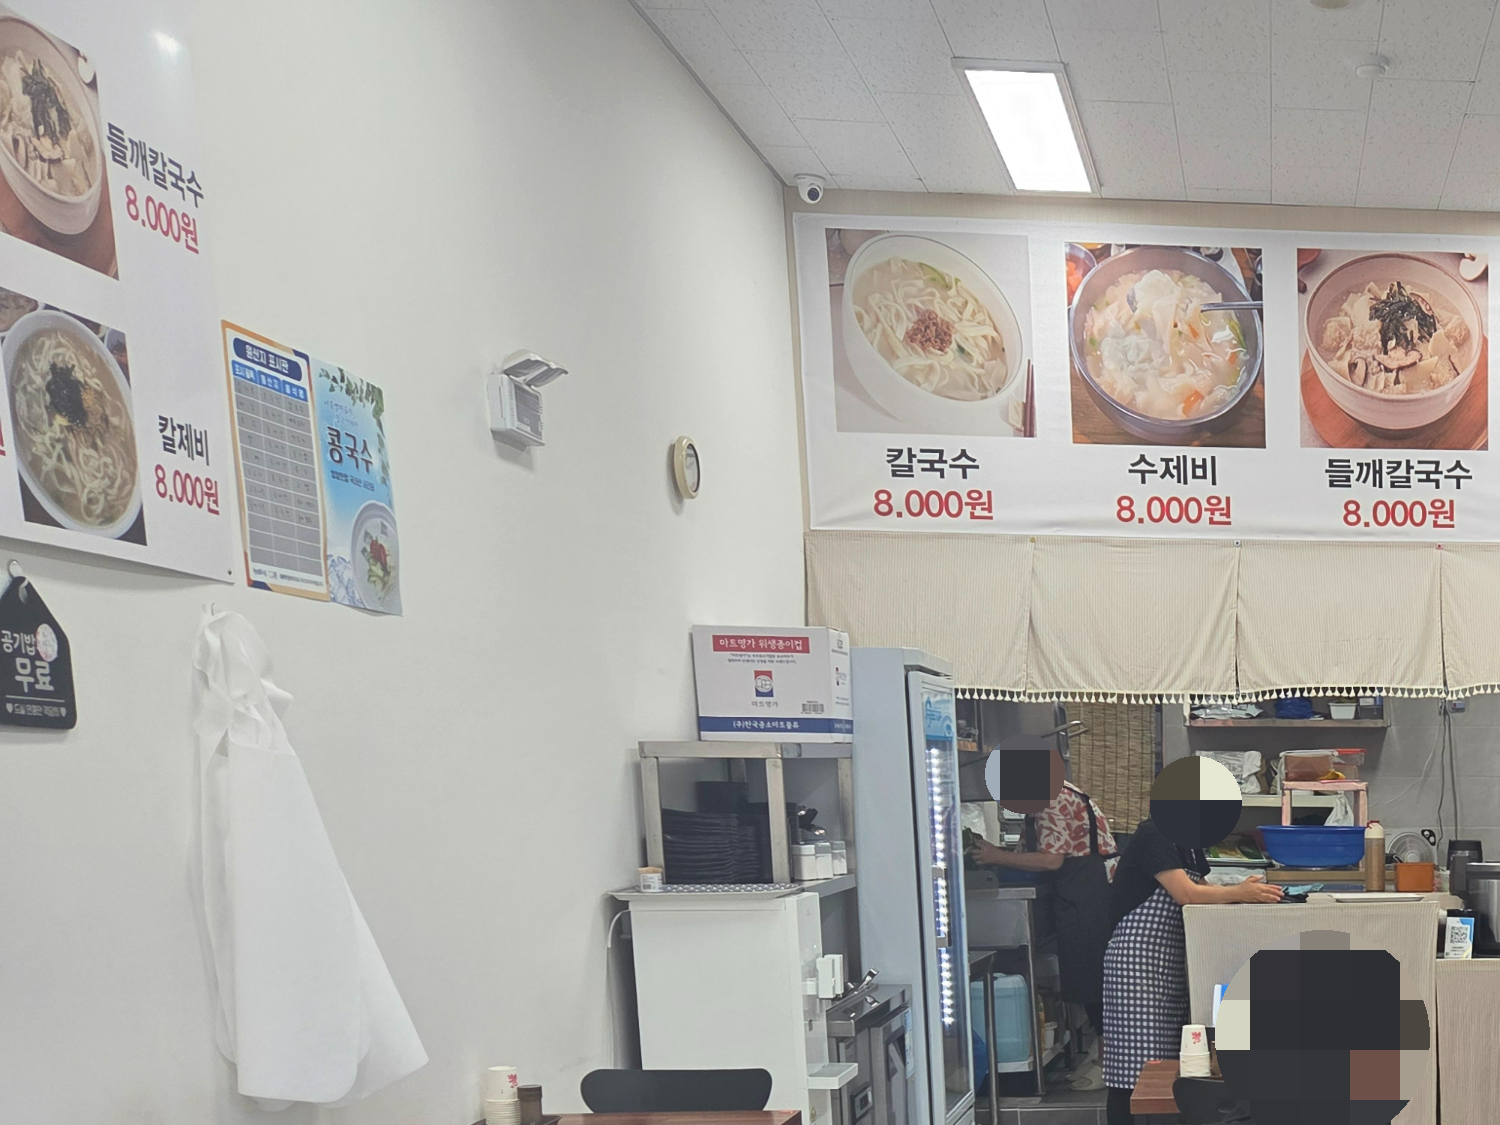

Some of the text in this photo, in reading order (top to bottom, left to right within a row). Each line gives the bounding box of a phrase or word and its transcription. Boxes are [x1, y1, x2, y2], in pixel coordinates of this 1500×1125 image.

[107, 123, 204, 208] 들깨칼국수
[125, 185, 199, 254] 8.000원
[245, 344, 289, 373] 원산지 표시판
[158, 415, 209, 466] 칼제비
[326, 425, 373, 474] 콩국수
[885, 448, 979, 480] 칼국수
[1128, 455, 1218, 487] 수제비
[1324, 459, 1473, 491] 들깨칼국수
[155, 464, 220, 515] 8.000원
[874, 489, 993, 522] 8.000원
[1116, 494, 1232, 528] 8.000원
[1342, 499, 1455, 530] 8.000원
[0, 629, 36, 656] 공기밥
[719, 638, 803, 651] 마트명가 위생종이컵
[15, 657, 55, 693] 무료
